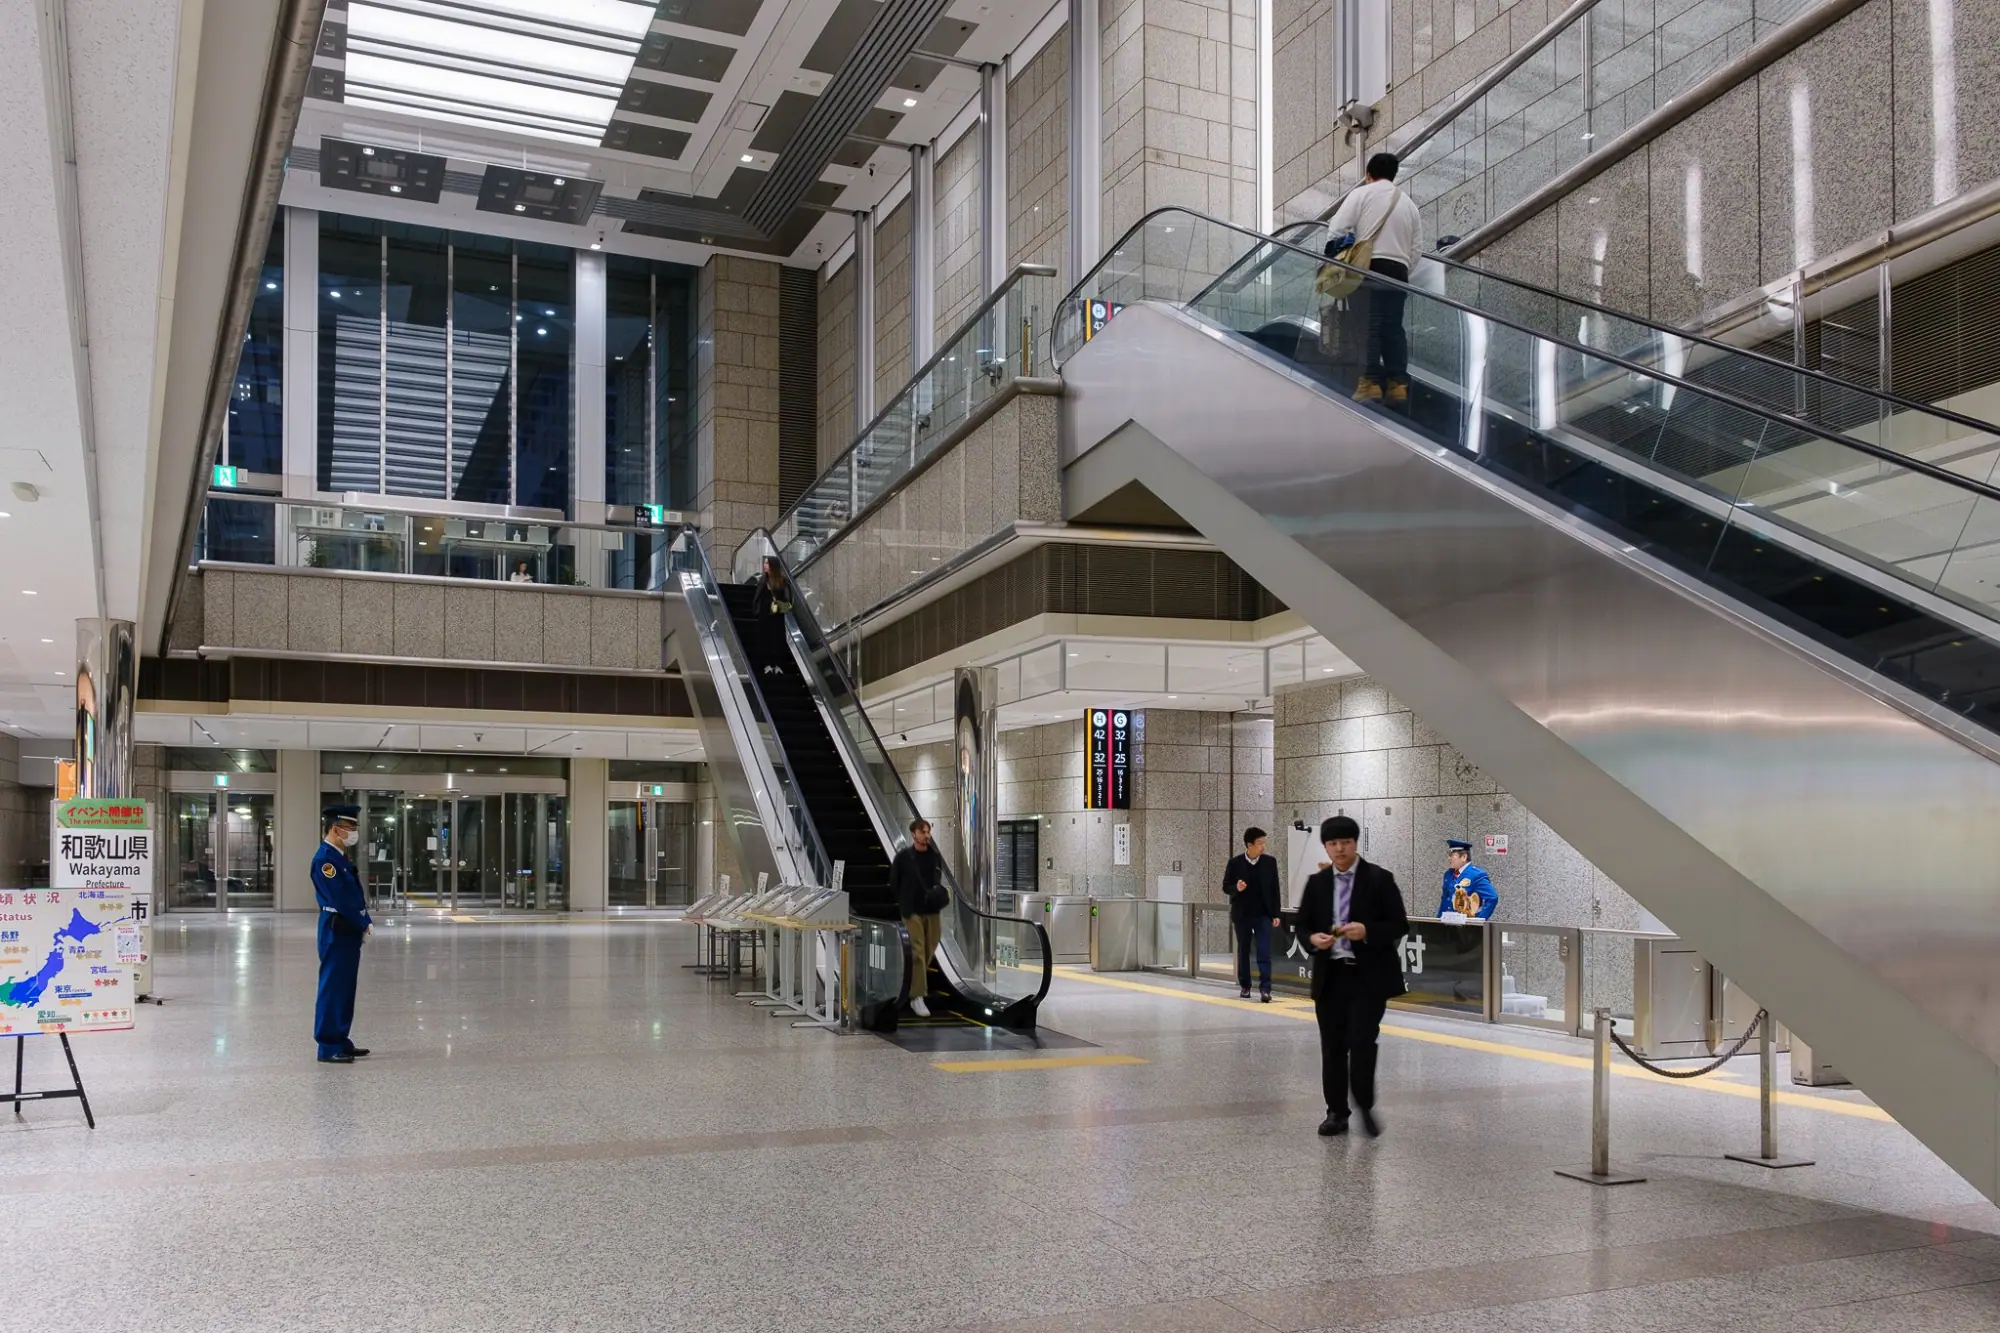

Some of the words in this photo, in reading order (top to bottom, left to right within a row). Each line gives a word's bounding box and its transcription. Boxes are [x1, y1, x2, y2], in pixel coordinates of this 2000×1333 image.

[1094, 730, 1105, 739] 42
[1115, 730, 1126, 740] 32
[1094, 753, 1105, 763] 32
[1115, 754, 1126, 764] 25
[66, 805, 144, 818] イベント開催中
[61, 834, 148, 860] 和歌山県
[69, 862, 141, 878] Wakayama
[86, 880, 125, 888] Prefecture
[78, 890, 105, 899] 北海道
[0, 913, 33, 922] Status
[54, 984, 72, 993] 東京
